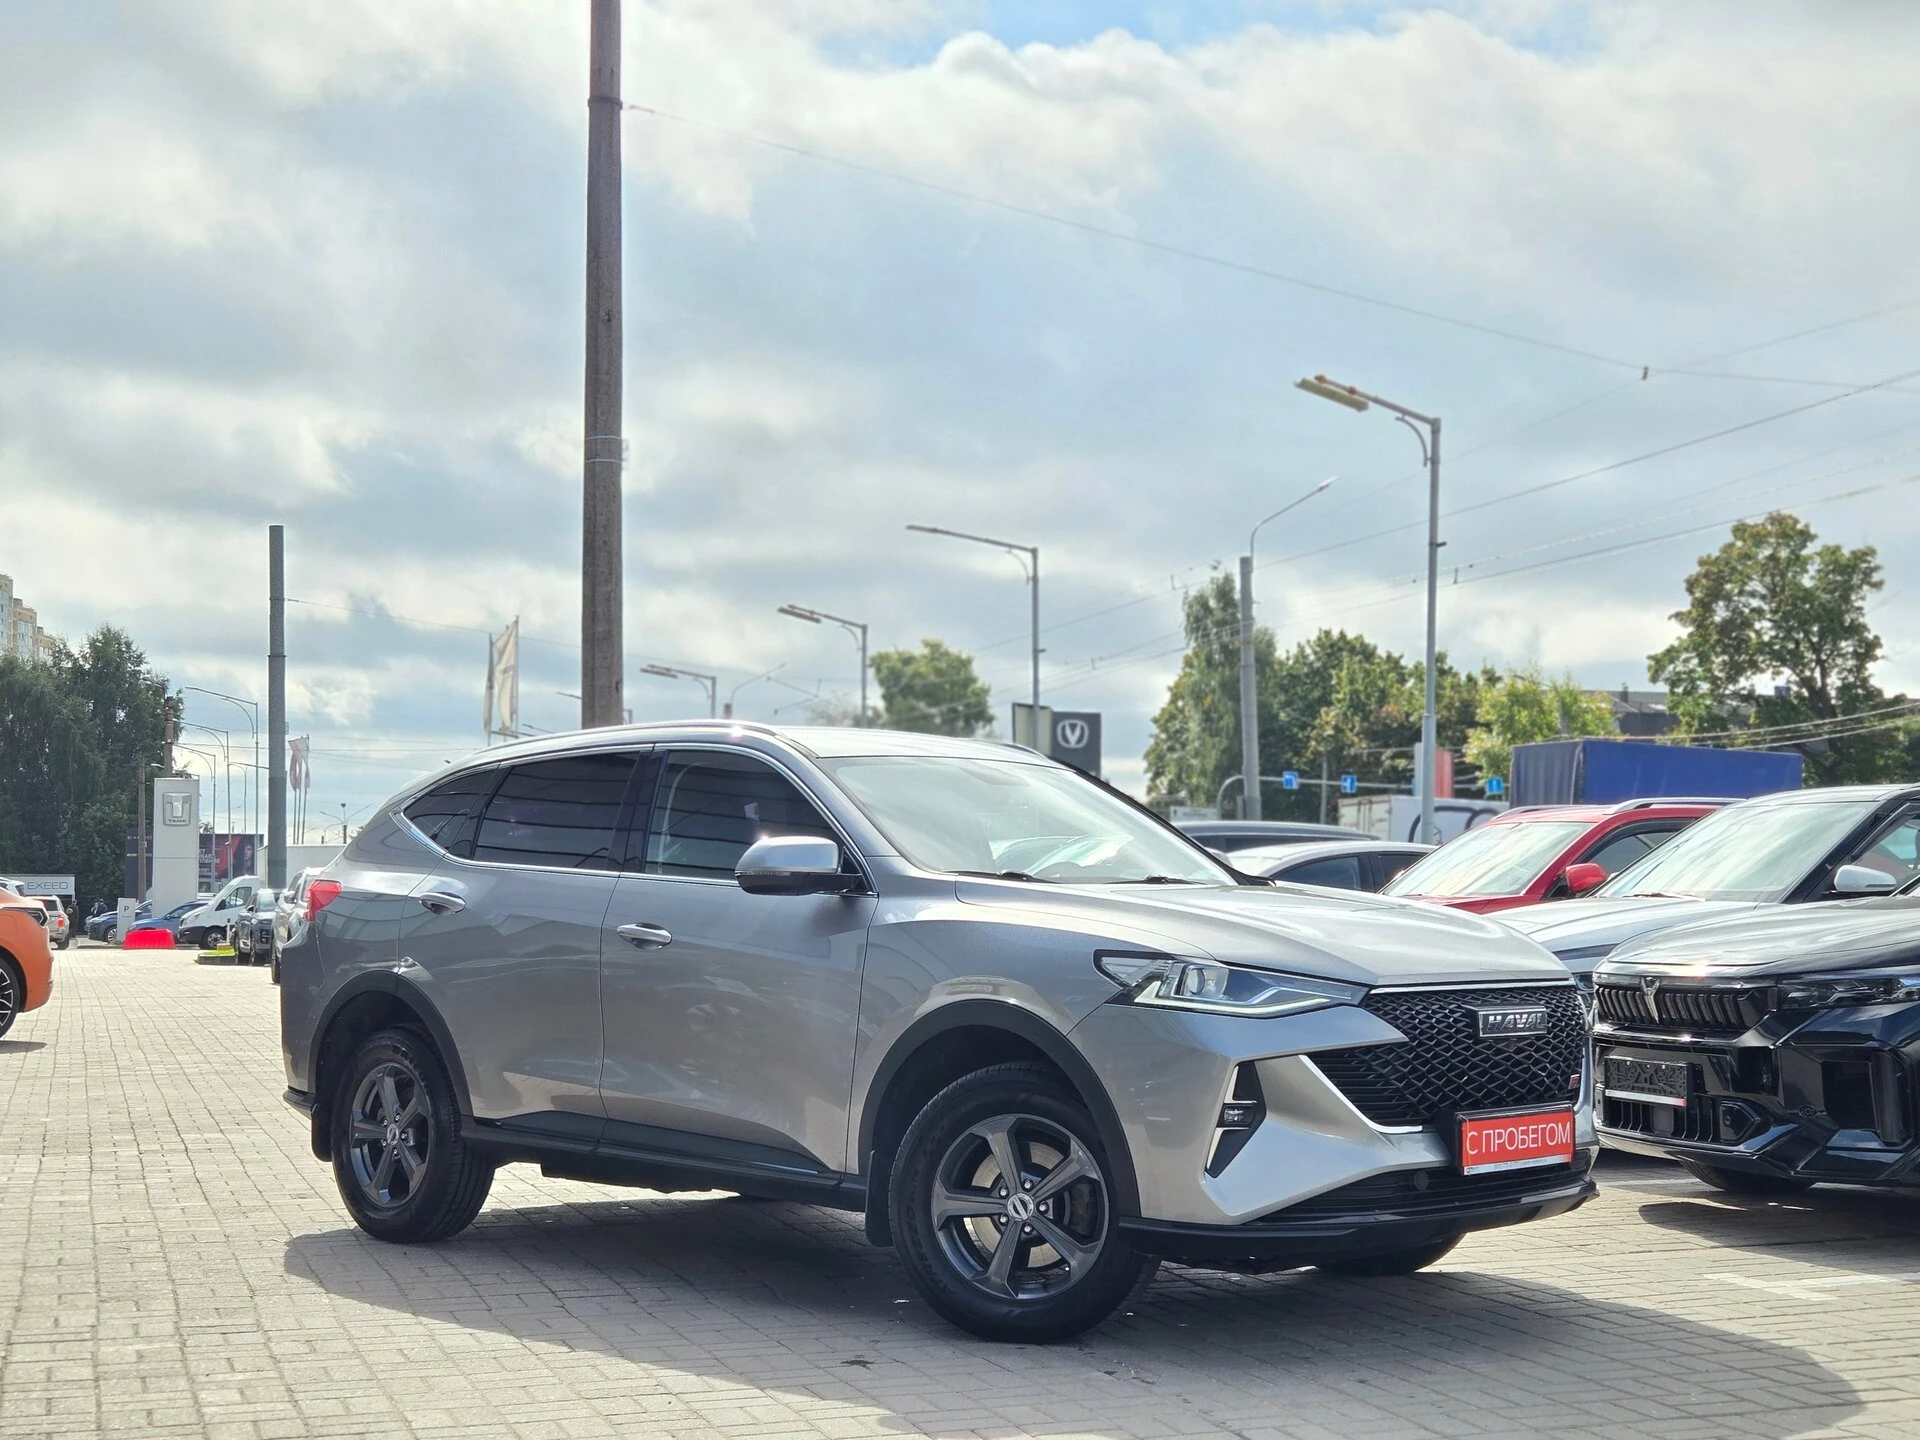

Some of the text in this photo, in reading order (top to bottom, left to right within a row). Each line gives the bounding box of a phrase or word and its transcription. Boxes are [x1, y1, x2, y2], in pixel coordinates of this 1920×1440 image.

[27, 881, 68, 890] EXEED
[1486, 1013, 1546, 1031] HAVAL
[1466, 1122, 1570, 1155] С ПРОБЕГОМ
